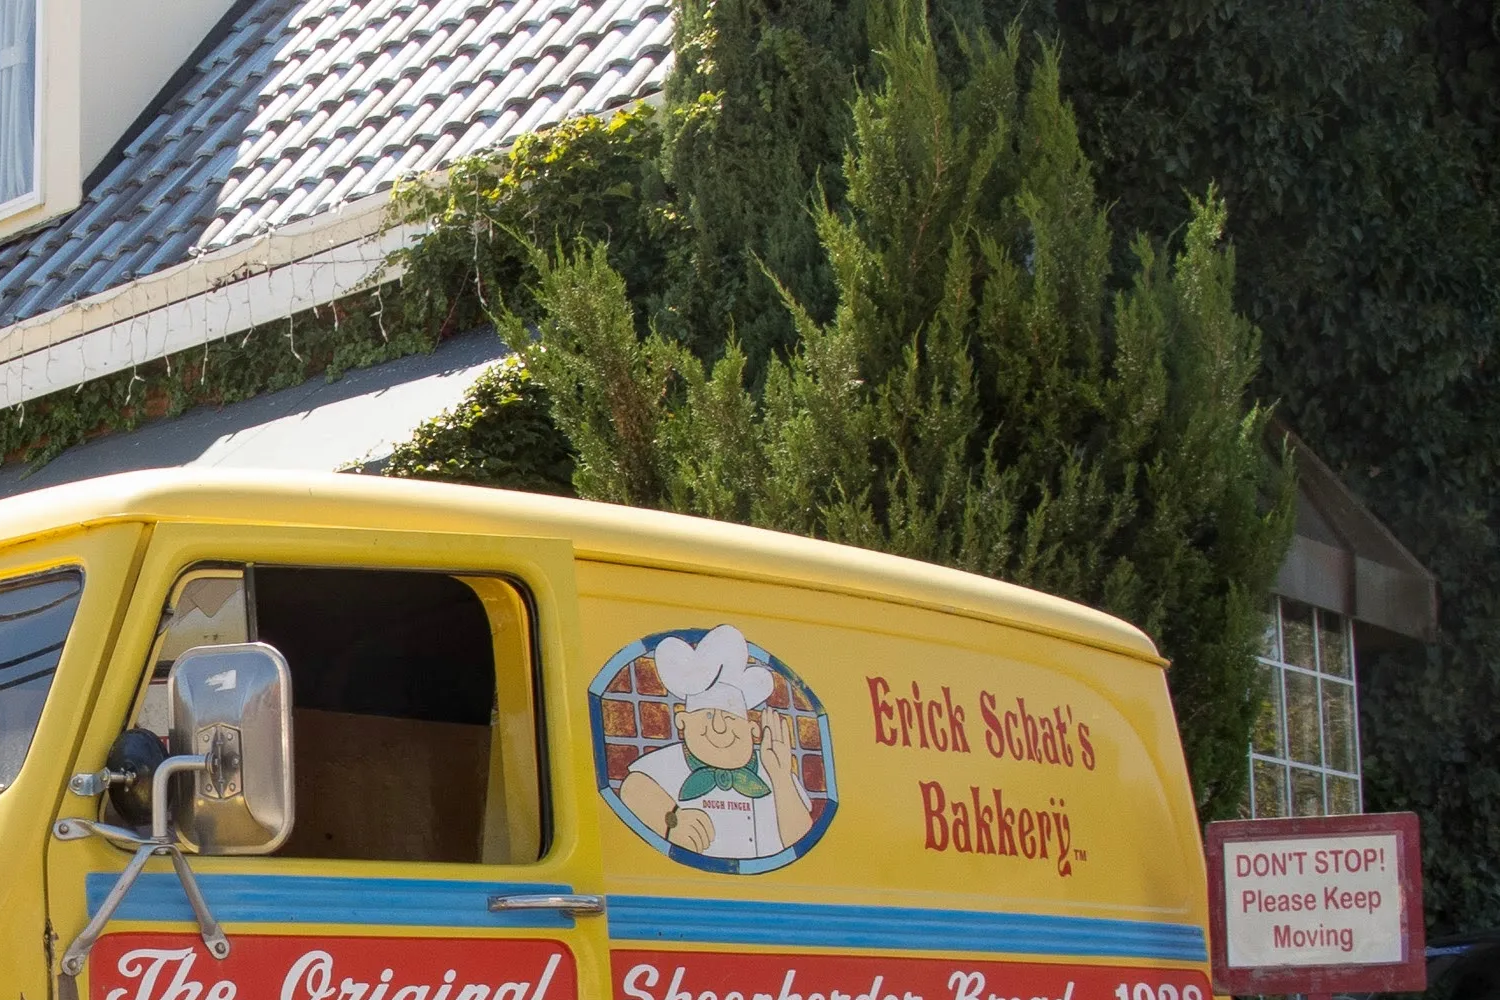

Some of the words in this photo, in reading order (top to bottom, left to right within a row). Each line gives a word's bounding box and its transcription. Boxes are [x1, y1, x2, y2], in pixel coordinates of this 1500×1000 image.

[865, 675, 971, 753] Erick
[979, 690, 1095, 771] Schat's
[1236, 852, 1307, 877] DON'T
[1315, 848, 1385, 874] STOP!
[1242, 889, 1317, 913] Please
[1324, 886, 1381, 914] Keep
[1274, 923, 1353, 951] Moving
